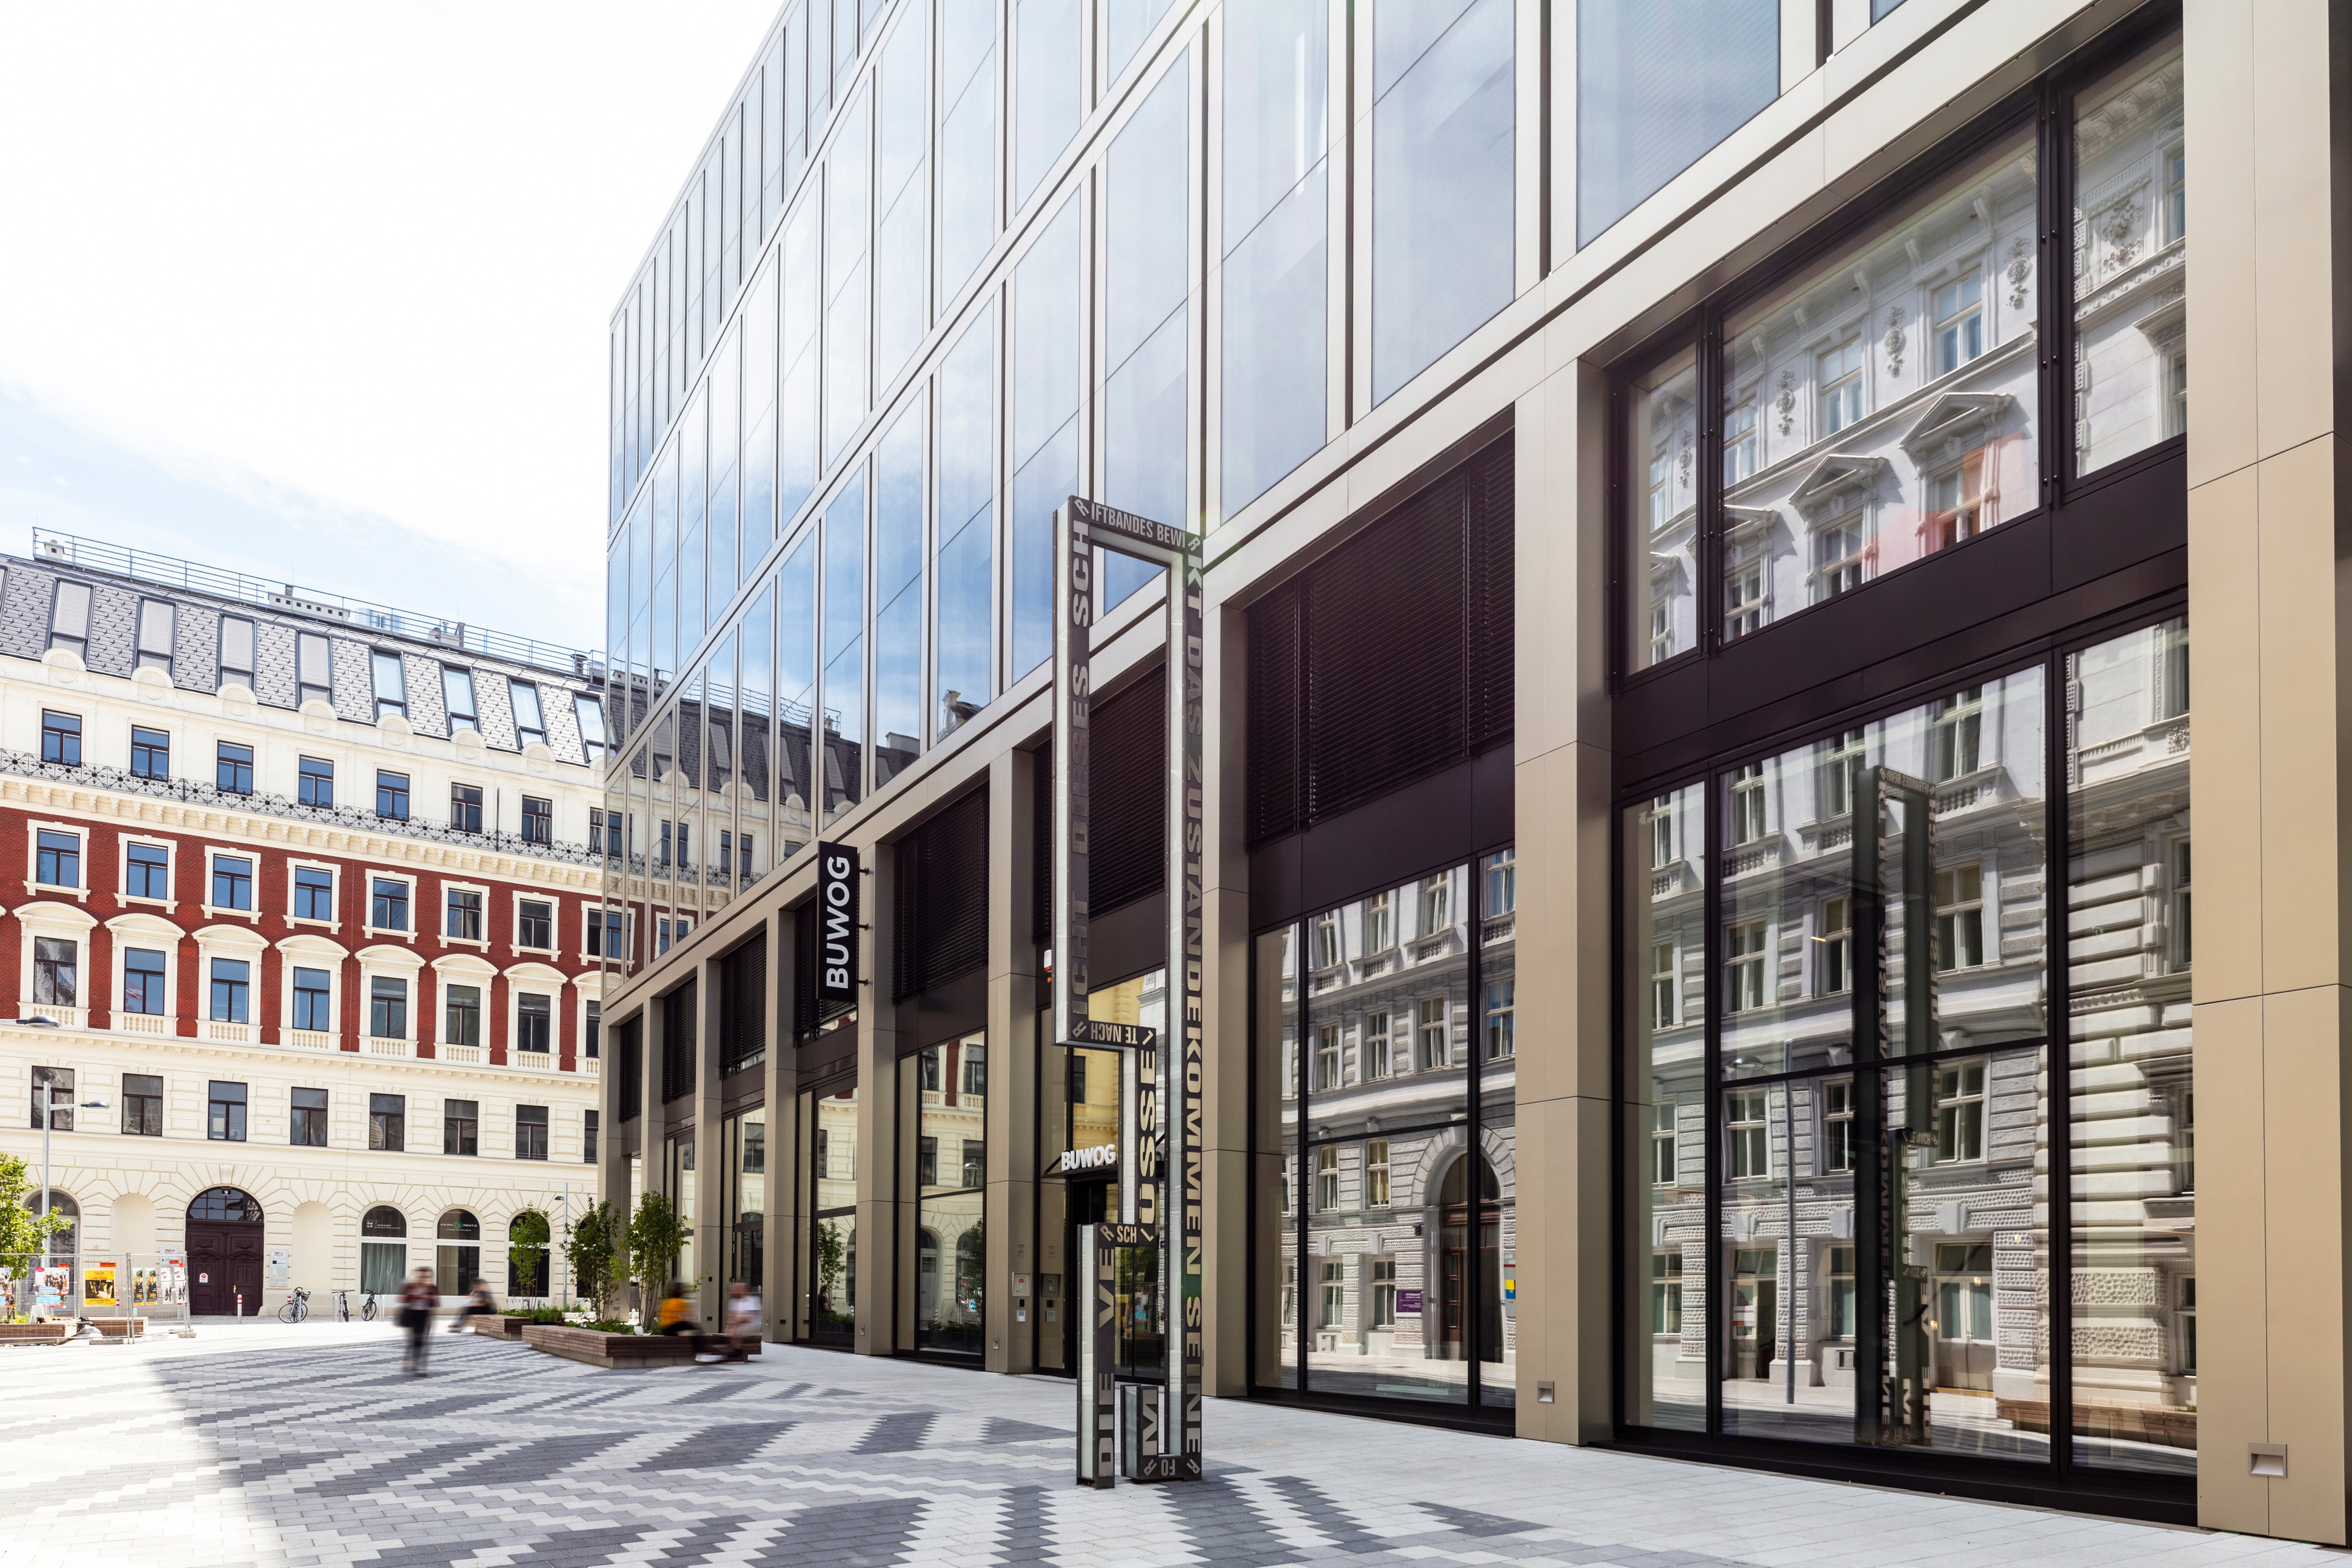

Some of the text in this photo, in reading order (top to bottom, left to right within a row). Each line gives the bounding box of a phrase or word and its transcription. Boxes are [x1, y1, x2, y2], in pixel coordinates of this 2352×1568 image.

[1187, 635, 1202, 736] DAS
[826, 856, 850, 989] BUWOG
[1061, 1144, 1117, 1171] BUWOG
[1098, 1373, 1114, 1477] DIE
